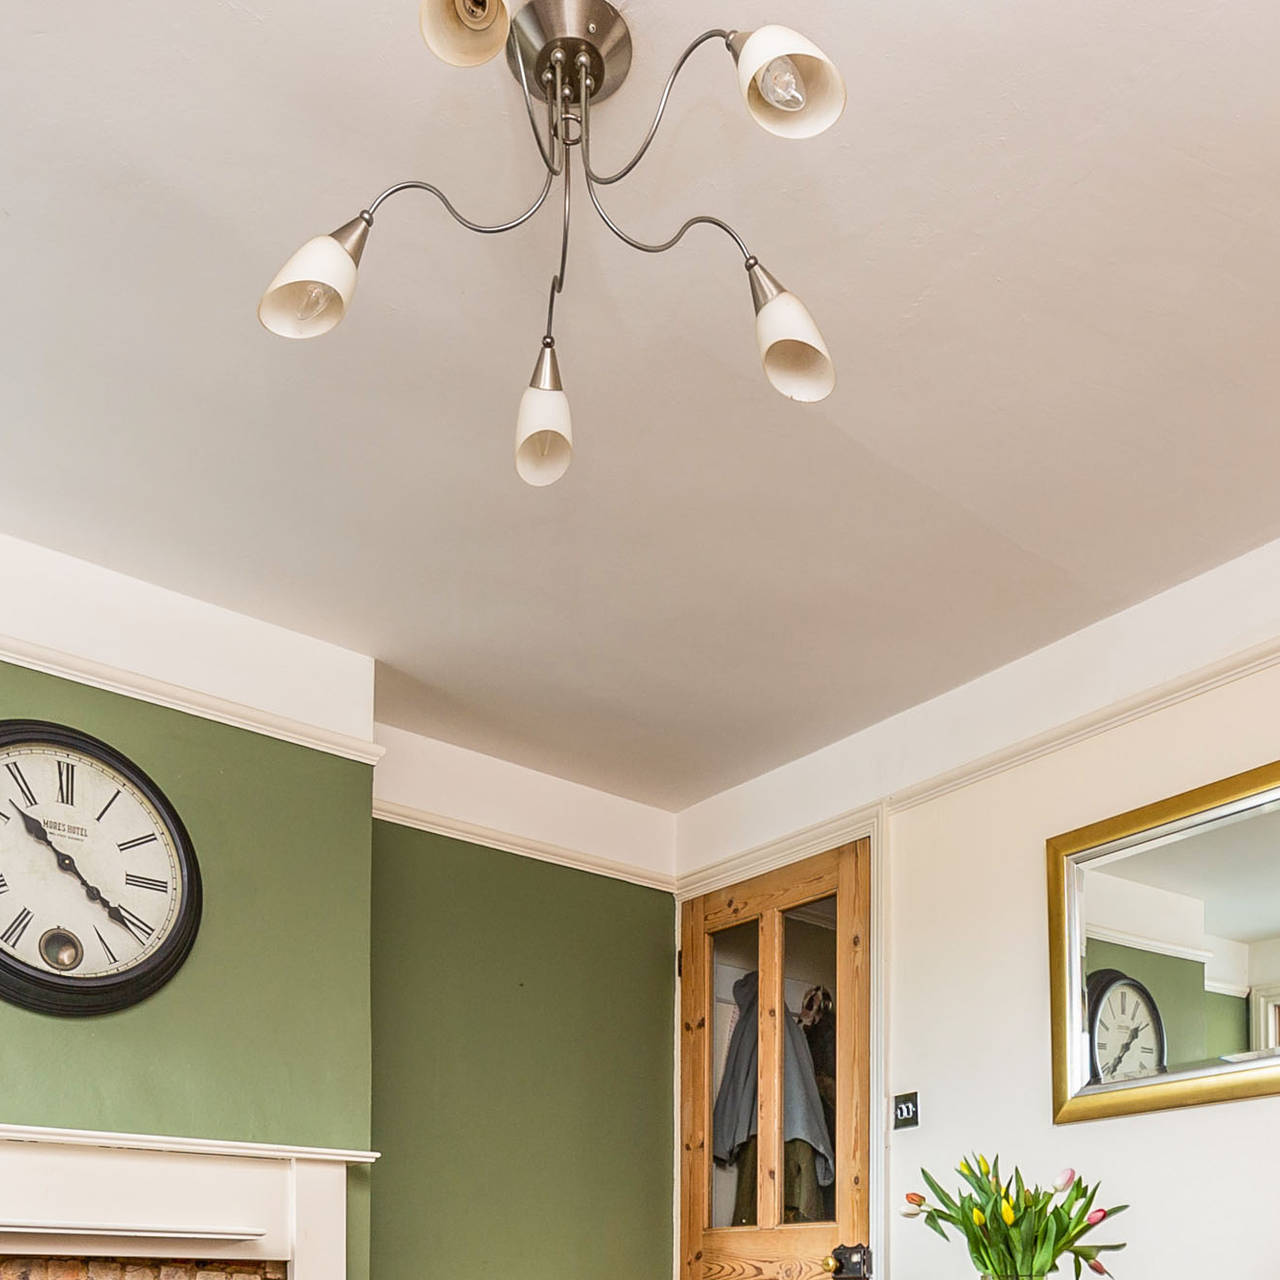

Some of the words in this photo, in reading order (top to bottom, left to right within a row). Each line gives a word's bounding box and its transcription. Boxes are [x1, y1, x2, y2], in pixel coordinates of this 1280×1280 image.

[4, 761, 39, 808] XI
[56, 760, 76, 806] XII
[117, 832, 157, 852] II
[125, 872, 168, 893] III
[0, 905, 35, 949] VII
